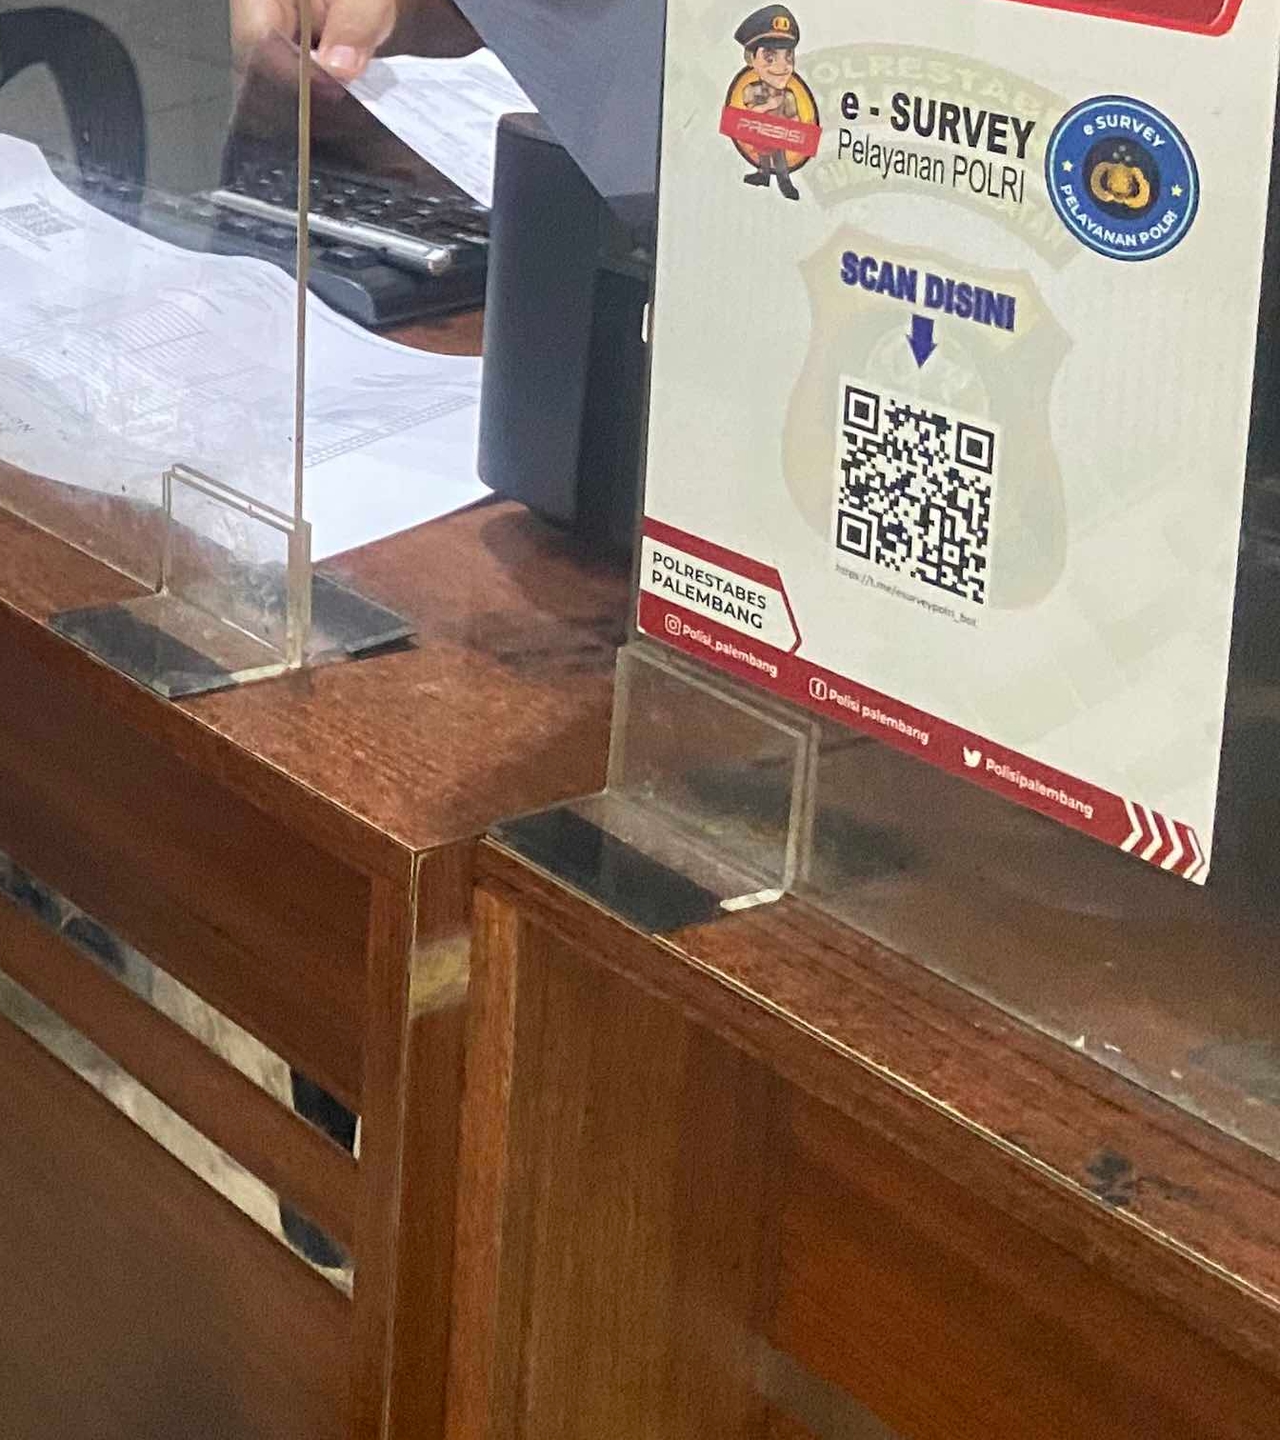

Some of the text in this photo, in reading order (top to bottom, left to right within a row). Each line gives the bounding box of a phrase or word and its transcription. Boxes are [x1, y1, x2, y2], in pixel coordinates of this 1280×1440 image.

[841, 91, 859, 120] e
[890, 92, 1036, 159] SURVEY
[838, 129, 945, 185] Pelayanan
[952, 154, 1024, 203] POLRI
[1060, 184, 1137, 247] PELAYANAN
[1140, 210, 1178, 245] POLRI
[841, 250, 1016, 333] SCAN DISINI
[652, 551, 766, 609] POLRESTABES
[652, 570, 763, 629] PALEMBANG
[682, 623, 778, 678] Polisi_palembang
[829, 688, 930, 746] Polisi palembang
[986, 758, 1094, 819] Polisipalembang
